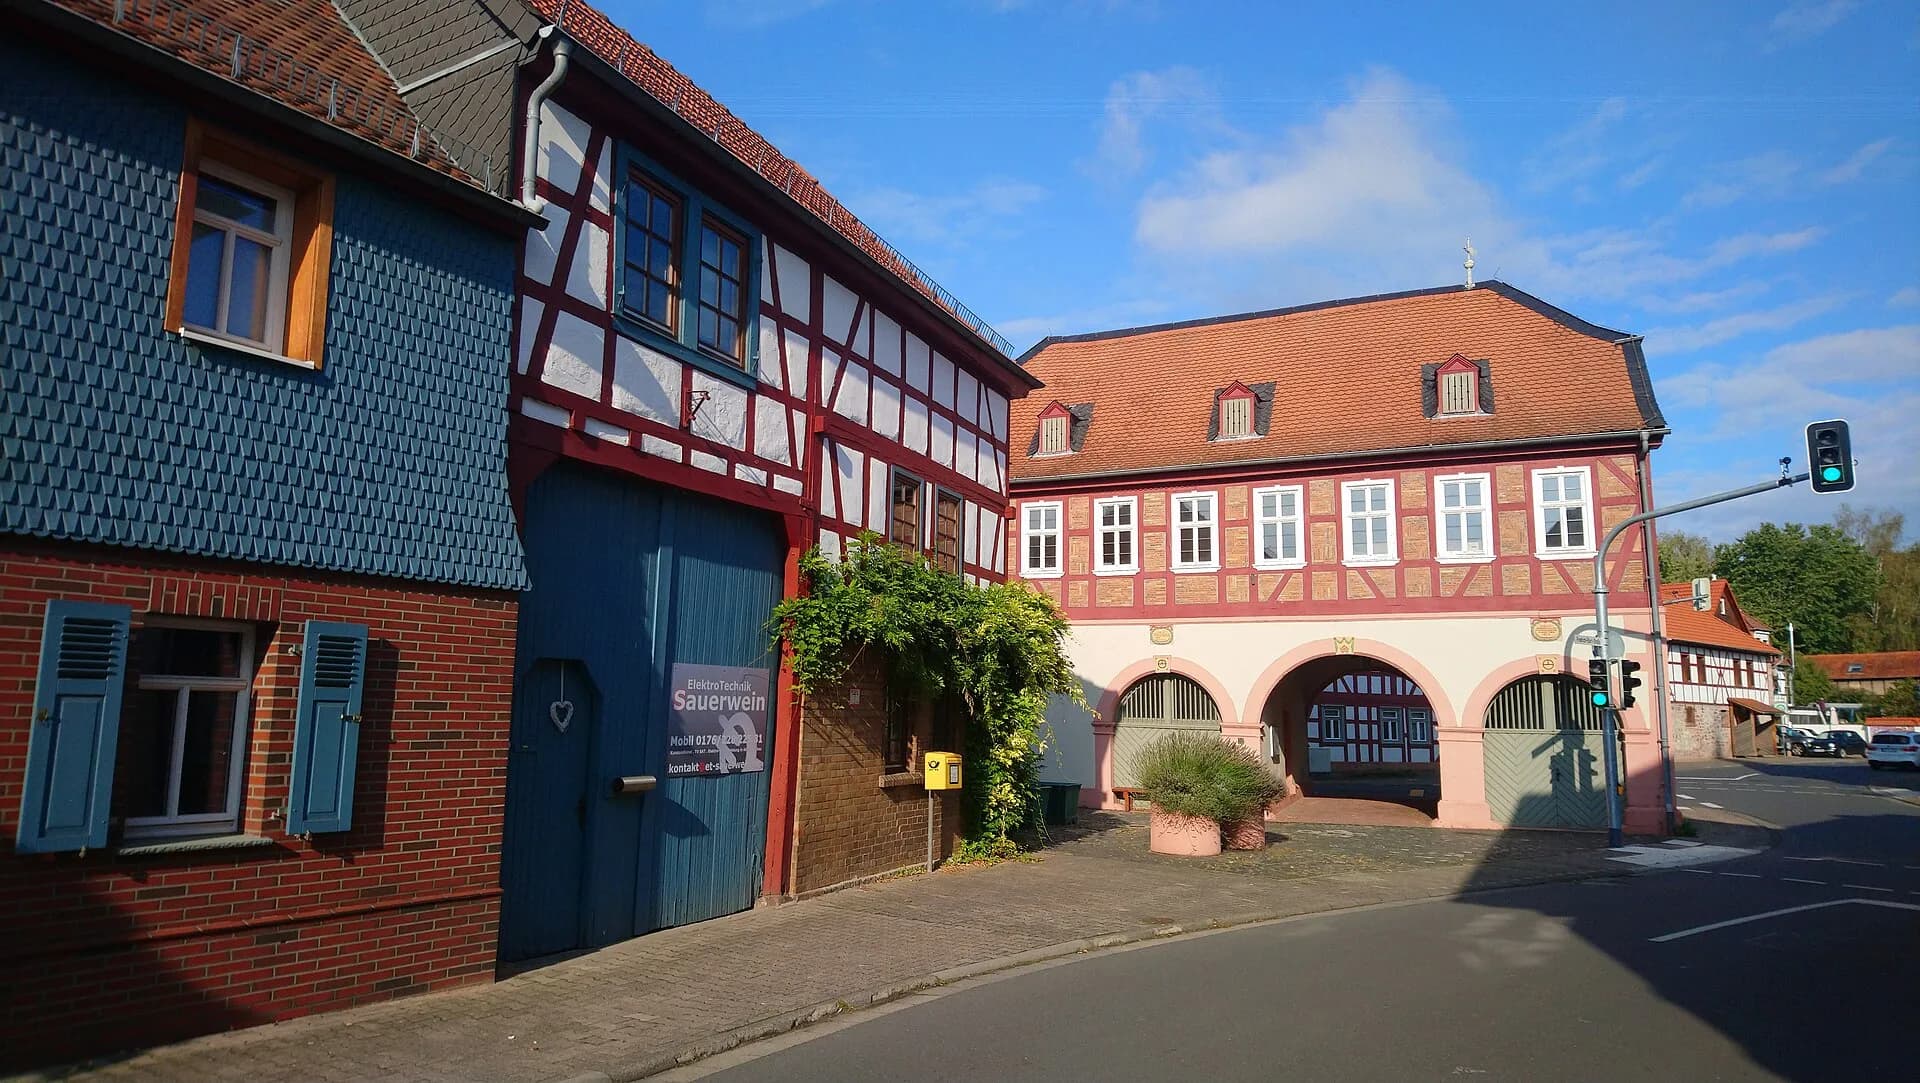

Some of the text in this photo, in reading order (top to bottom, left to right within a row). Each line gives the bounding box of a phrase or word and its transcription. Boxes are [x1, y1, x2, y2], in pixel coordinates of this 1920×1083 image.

[687, 679, 752, 691] ElektroTechnik
[673, 689, 765, 711] Sauerwein
[670, 735, 694, 746] Mobil
